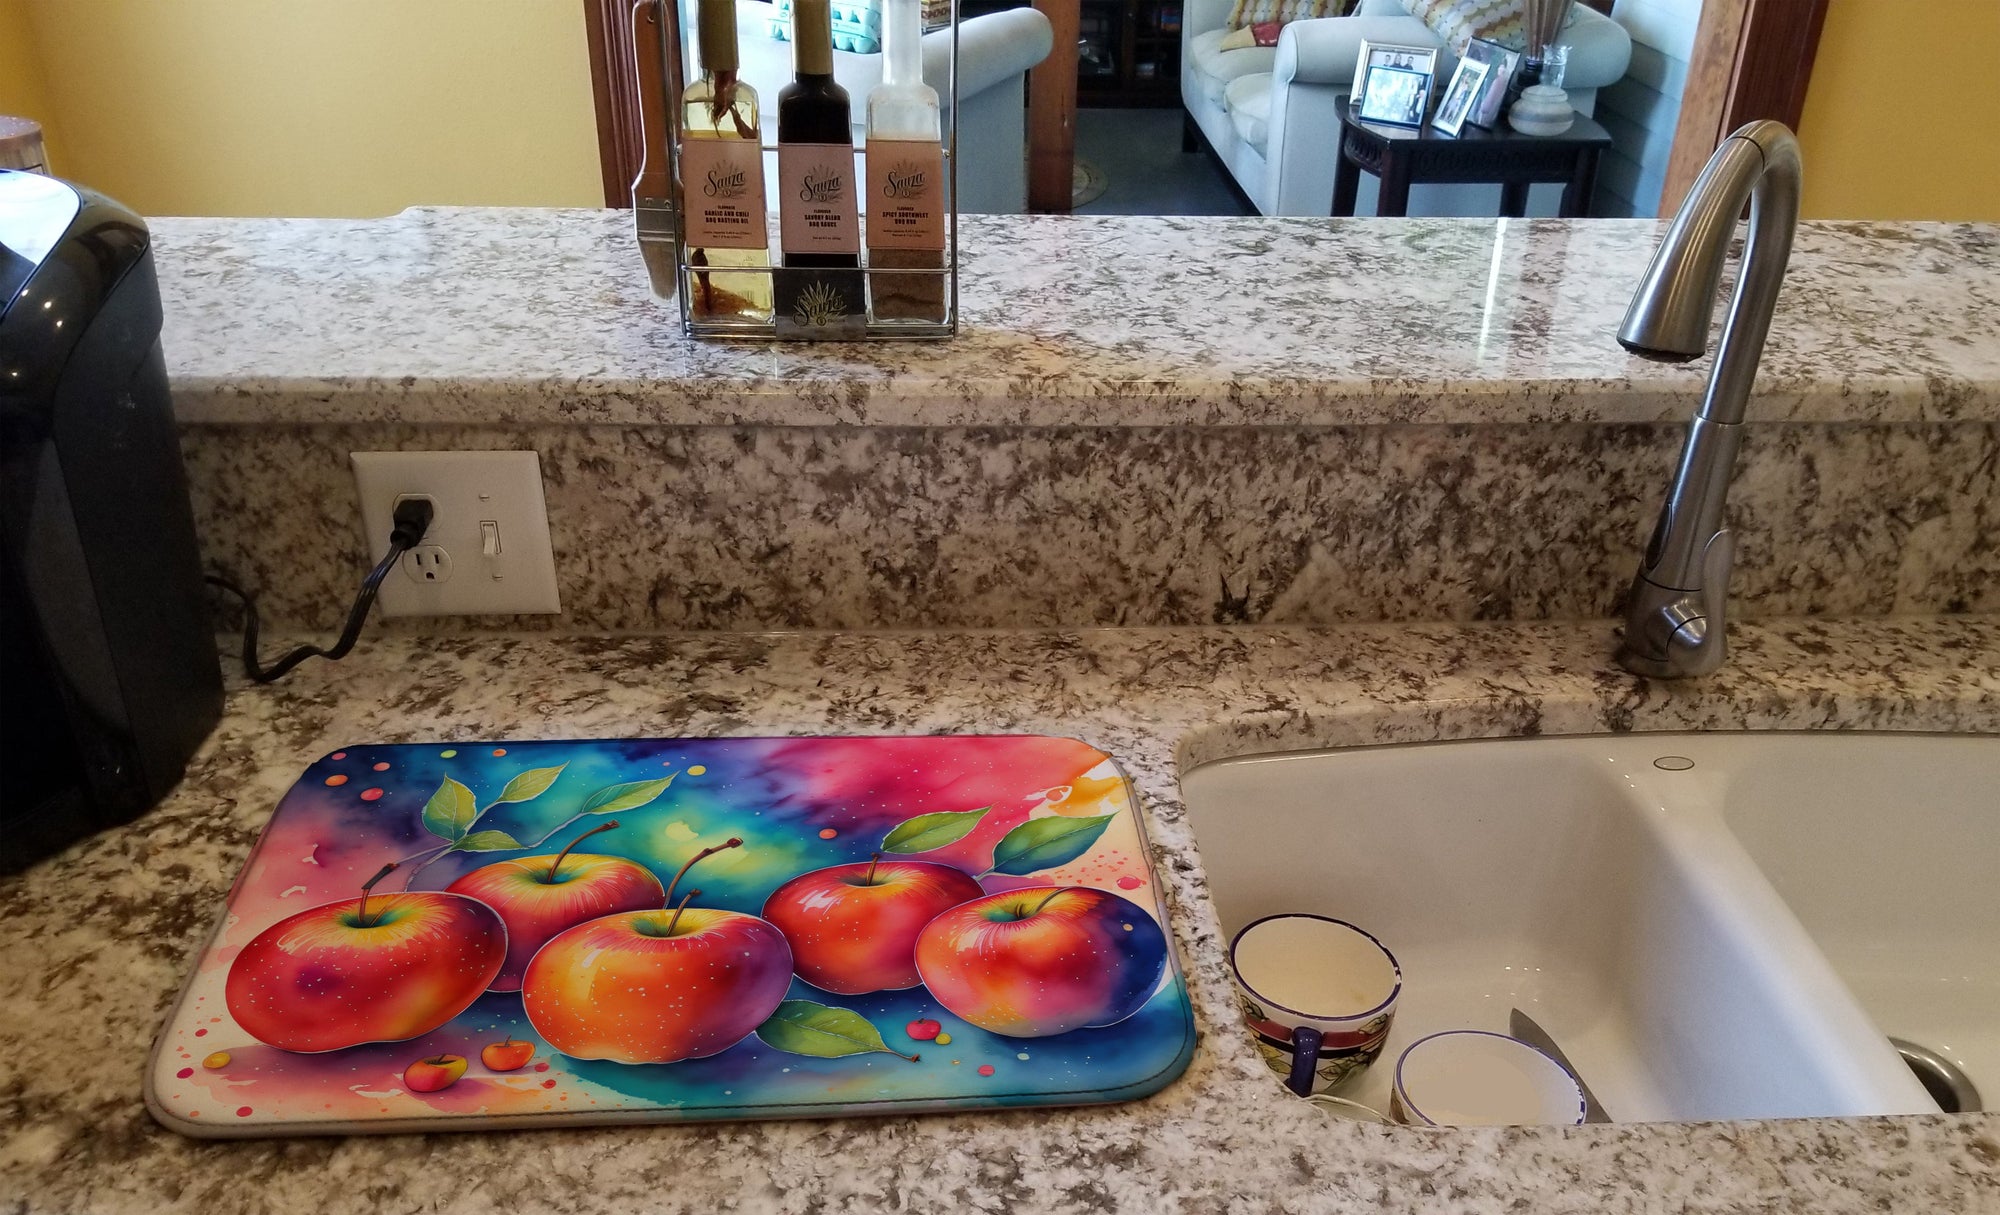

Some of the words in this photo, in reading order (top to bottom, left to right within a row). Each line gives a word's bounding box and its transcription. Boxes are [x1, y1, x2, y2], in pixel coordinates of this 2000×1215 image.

[703, 169, 746, 197] Sauza
[799, 175, 842, 202] Sauza
[884, 170, 925, 198] Sauza
[792, 295, 844, 327] Sauza
